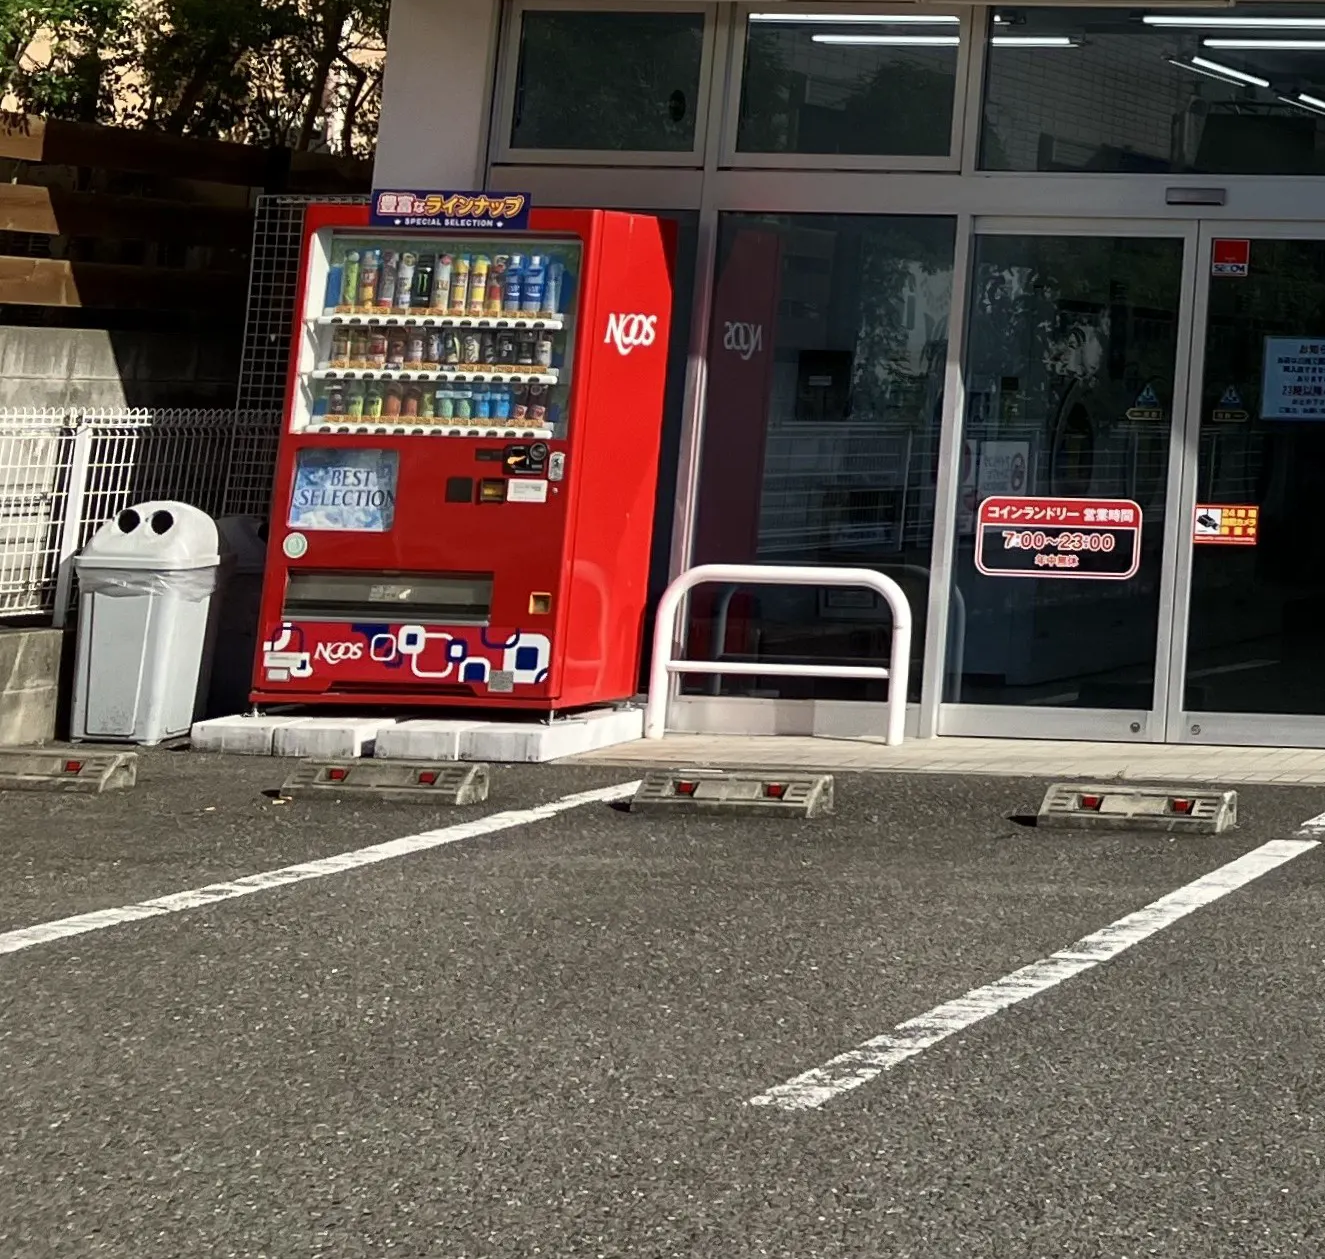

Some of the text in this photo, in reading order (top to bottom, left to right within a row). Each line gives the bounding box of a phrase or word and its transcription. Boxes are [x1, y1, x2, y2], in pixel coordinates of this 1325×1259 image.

[377, 192, 525, 219] 豊富なラインナップ
[404, 218, 494, 228] SPECIAL SELECTION
[330, 469, 373, 488] BEST
[299, 489, 395, 508] SELECTION
[987, 506, 1134, 523] コインランドリー 営業時間
